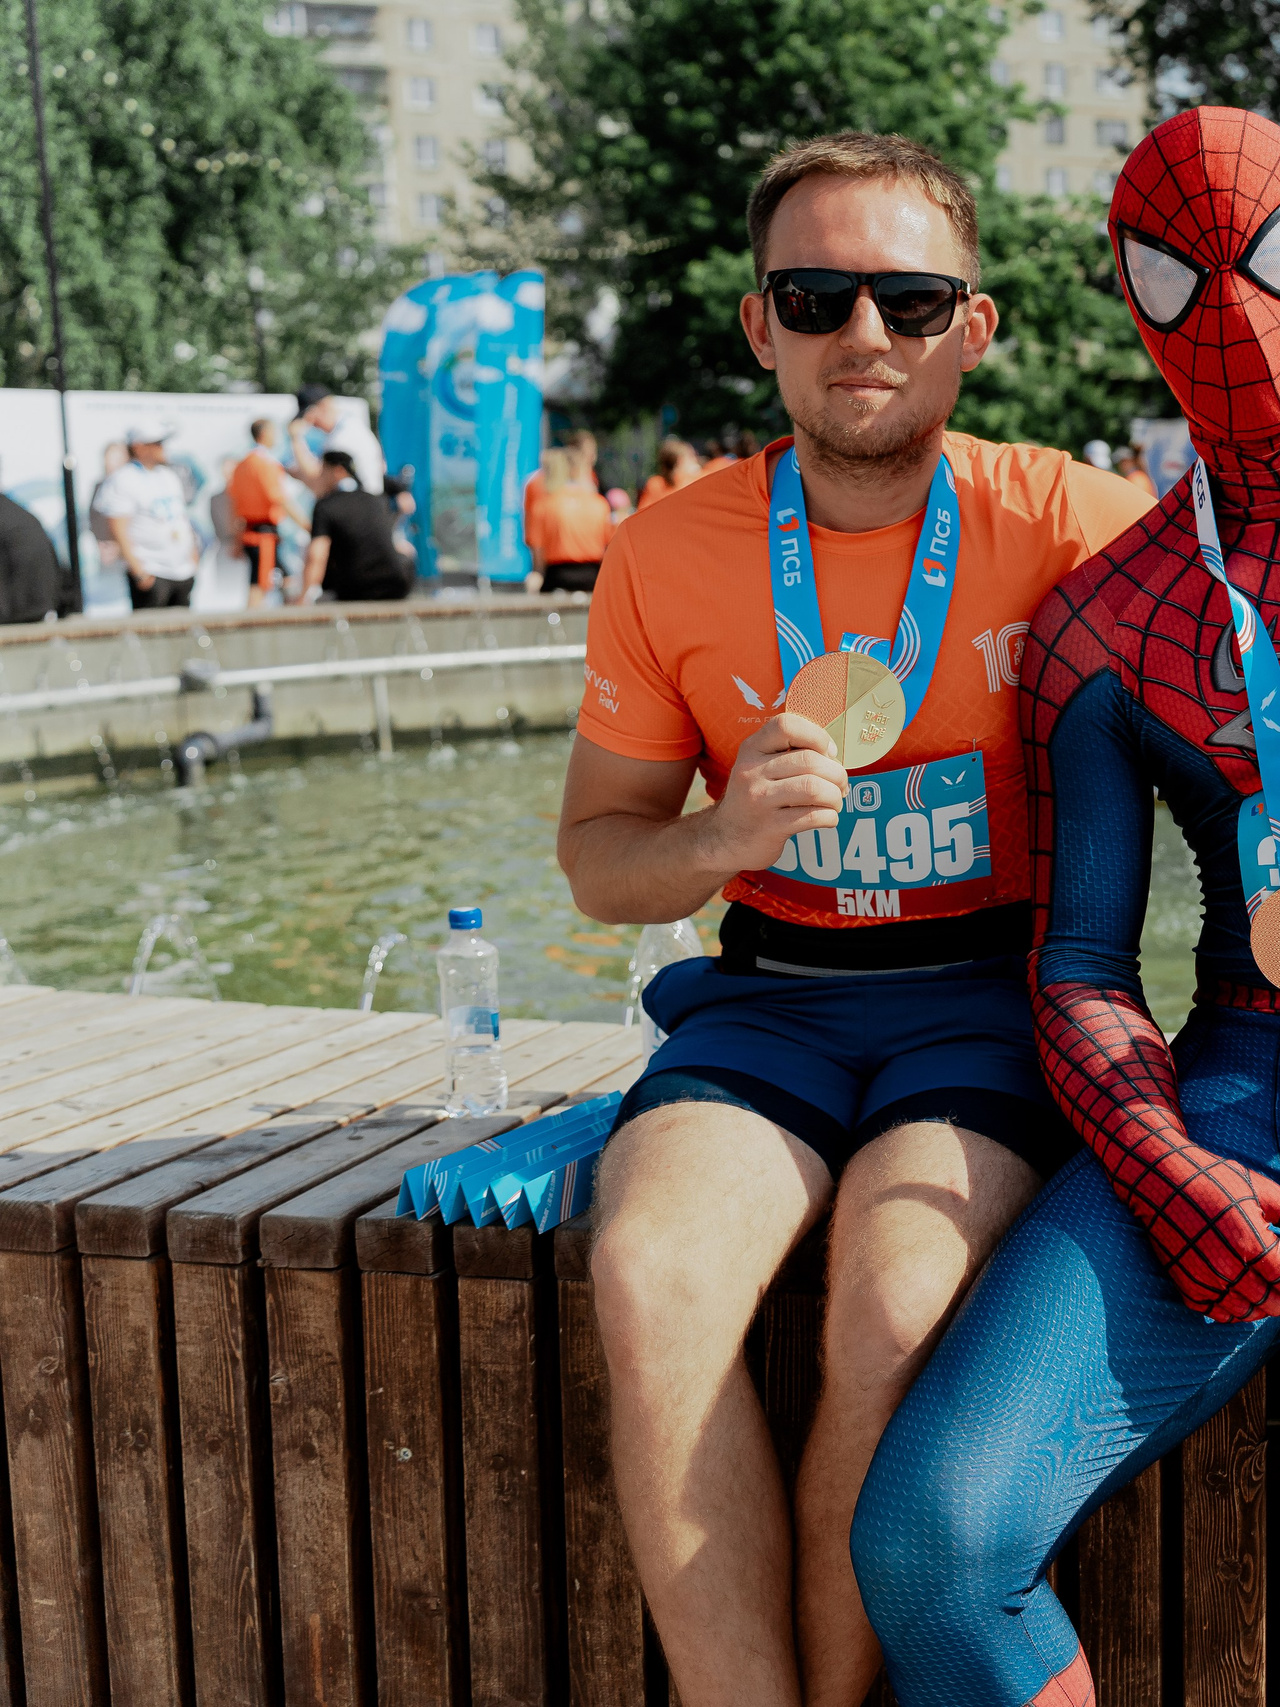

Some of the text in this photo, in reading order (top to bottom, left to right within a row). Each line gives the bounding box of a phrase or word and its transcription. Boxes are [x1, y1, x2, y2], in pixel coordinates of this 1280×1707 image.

[1195, 465, 1206, 510] ПСБ
[929, 507, 951, 556] ПСБ
[780, 537, 802, 587] ПСБ
[971, 621, 1031, 693] 10
[836, 887, 901, 918] 5KM
